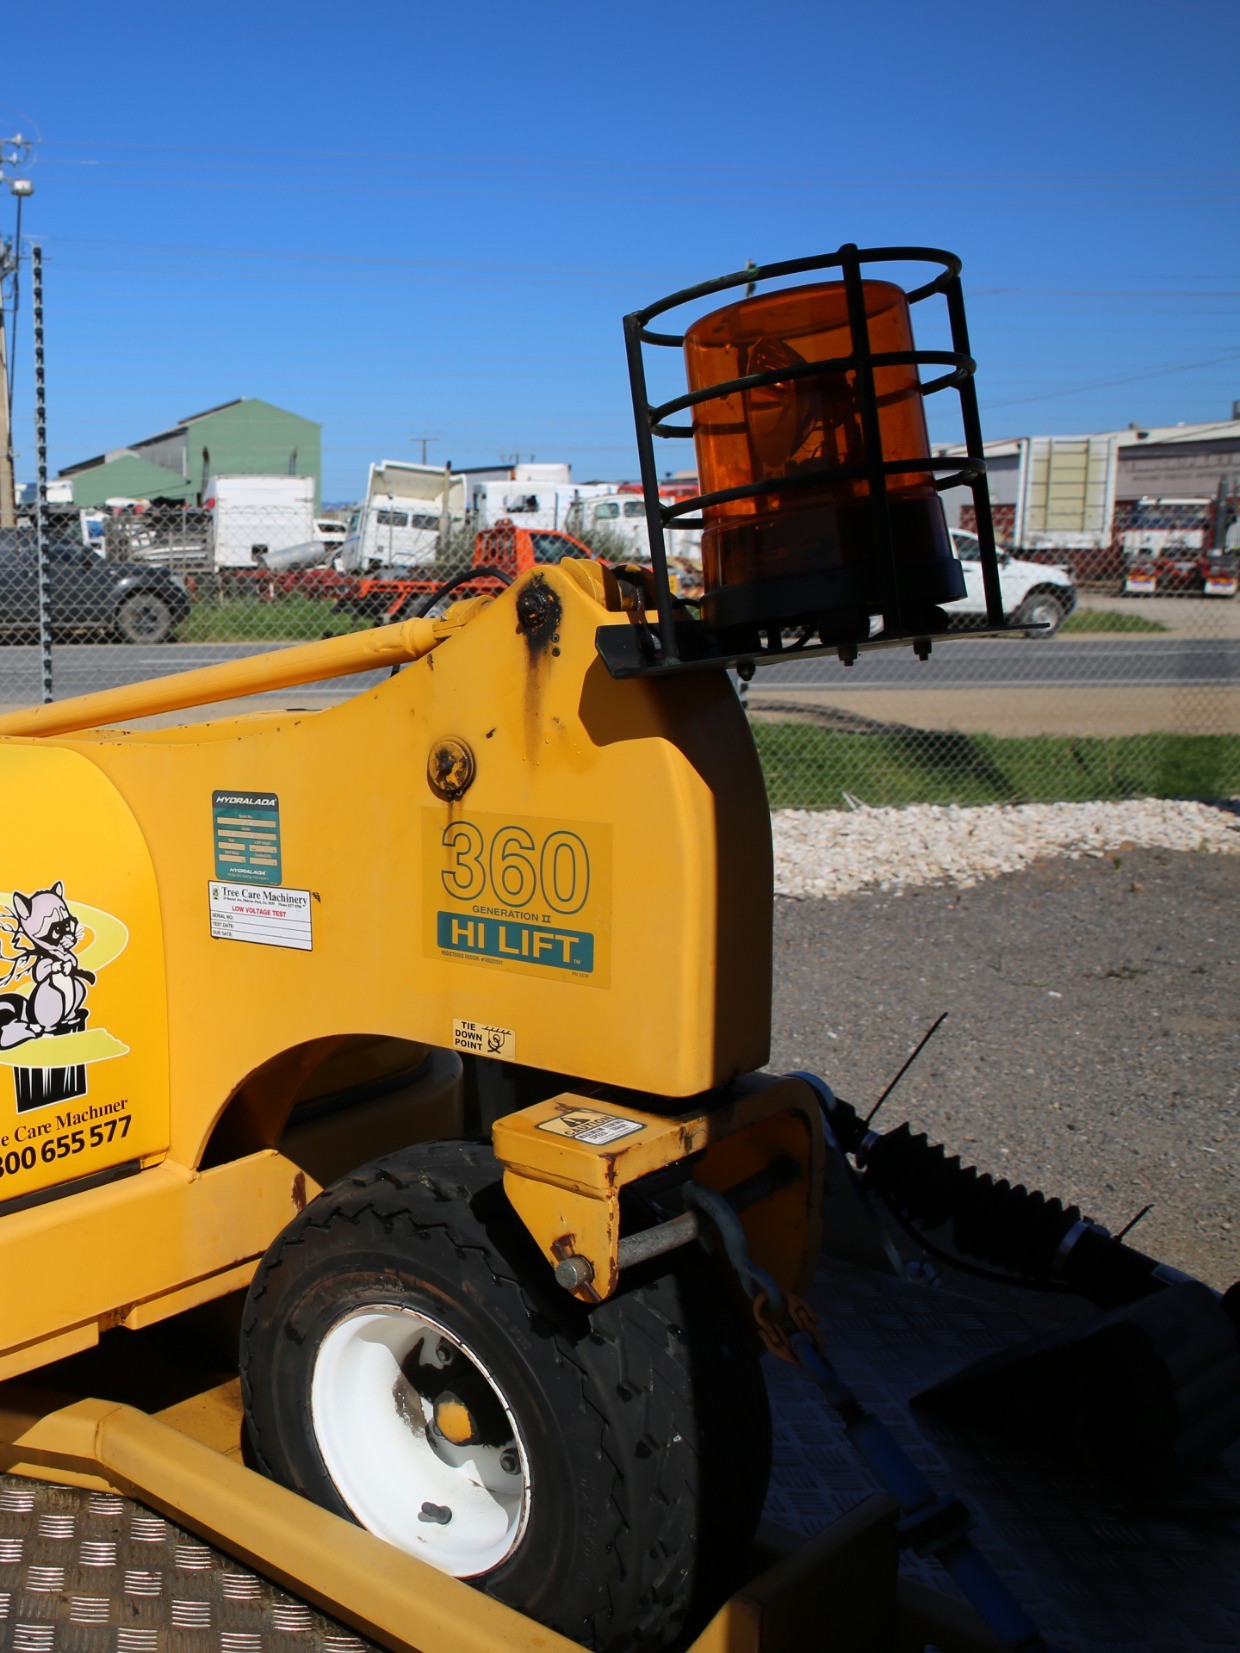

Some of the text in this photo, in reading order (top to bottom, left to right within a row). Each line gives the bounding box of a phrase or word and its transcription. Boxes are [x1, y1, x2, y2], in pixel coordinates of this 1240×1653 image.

[216, 796, 276, 806] HYDRALADA
[229, 867, 266, 876] HYDRALADA
[441, 820, 590, 915] 360
[221, 886, 240, 897] Tree
[241, 888, 261, 900] Care
[262, 891, 308, 908] Machinery
[232, 905, 287, 918] LOW VOLTAGE TEST
[472, 905, 551, 923] GENERATION II
[451, 918, 485, 949] HI
[499, 926, 579, 963] LIFT
[461, 1021, 476, 1031] TIE
[454, 1038, 483, 1051] POINT
[455, 1029, 483, 1042] DOWN
[14, 1122, 52, 1143] Care
[564, 1115, 615, 1135] CAUTION
[41, 1130, 85, 1163] 655
[89, 1114, 133, 1148] 577
